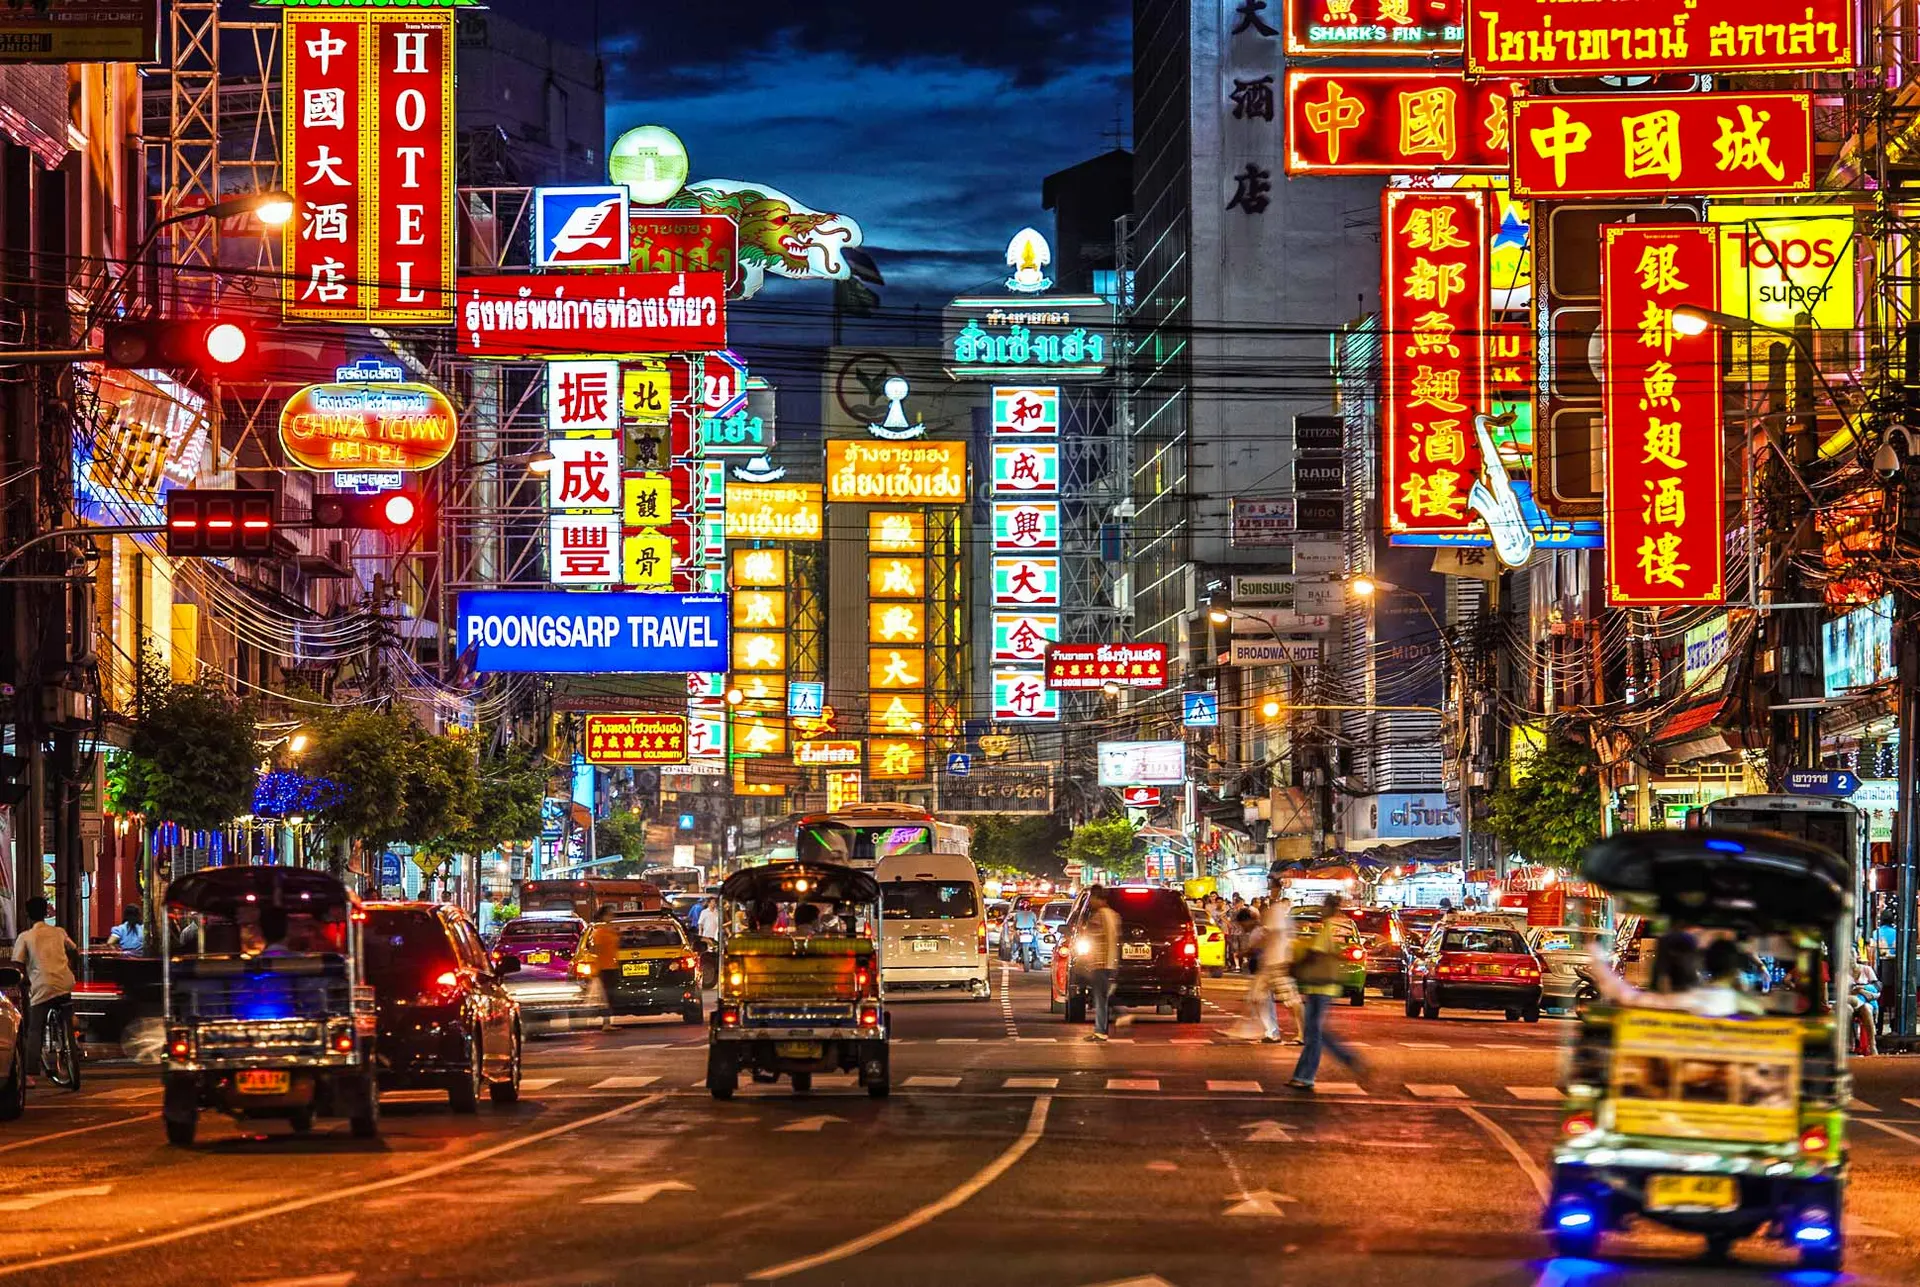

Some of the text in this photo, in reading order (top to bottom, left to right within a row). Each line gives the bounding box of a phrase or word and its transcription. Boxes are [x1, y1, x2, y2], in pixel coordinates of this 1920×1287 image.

[1310, 25, 1387, 41] SHARK'S
[1393, 26, 1422, 41] FIN
[1480, 7, 1838, 62] ไชน่าทาวน์ สกาล่า
[1530, 105, 1784, 188] 中國城
[302, 29, 352, 303] 中國大酒店
[393, 33, 428, 303] HOTEL
[1728, 232, 1835, 281] Tops
[465, 273, 717, 348] รุ่งทรัพย์การท่องเที่ยว
[1759, 284, 1833, 309] super
[1400, 206, 1470, 520] 銀都魚翅酒樓
[292, 413, 448, 441] CHINA TOWN
[1298, 427, 1341, 438] CITIZEN
[1635, 244, 1691, 588] 銀都魚翅酒樓
[330, 441, 407, 464] HOTEL
[845, 442, 949, 462] ห้างขายทอง
[558, 371, 611, 577] 振成豐
[1299, 467, 1341, 478] RADO
[1303, 508, 1336, 517] MIDO
[1010, 397, 1043, 713] 和成興大金行
[467, 615, 718, 648] ROONGSARP TRAVEL
[1237, 647, 1289, 660] BROADWAY
[1792, 774, 1848, 789] เยาวราช 2
